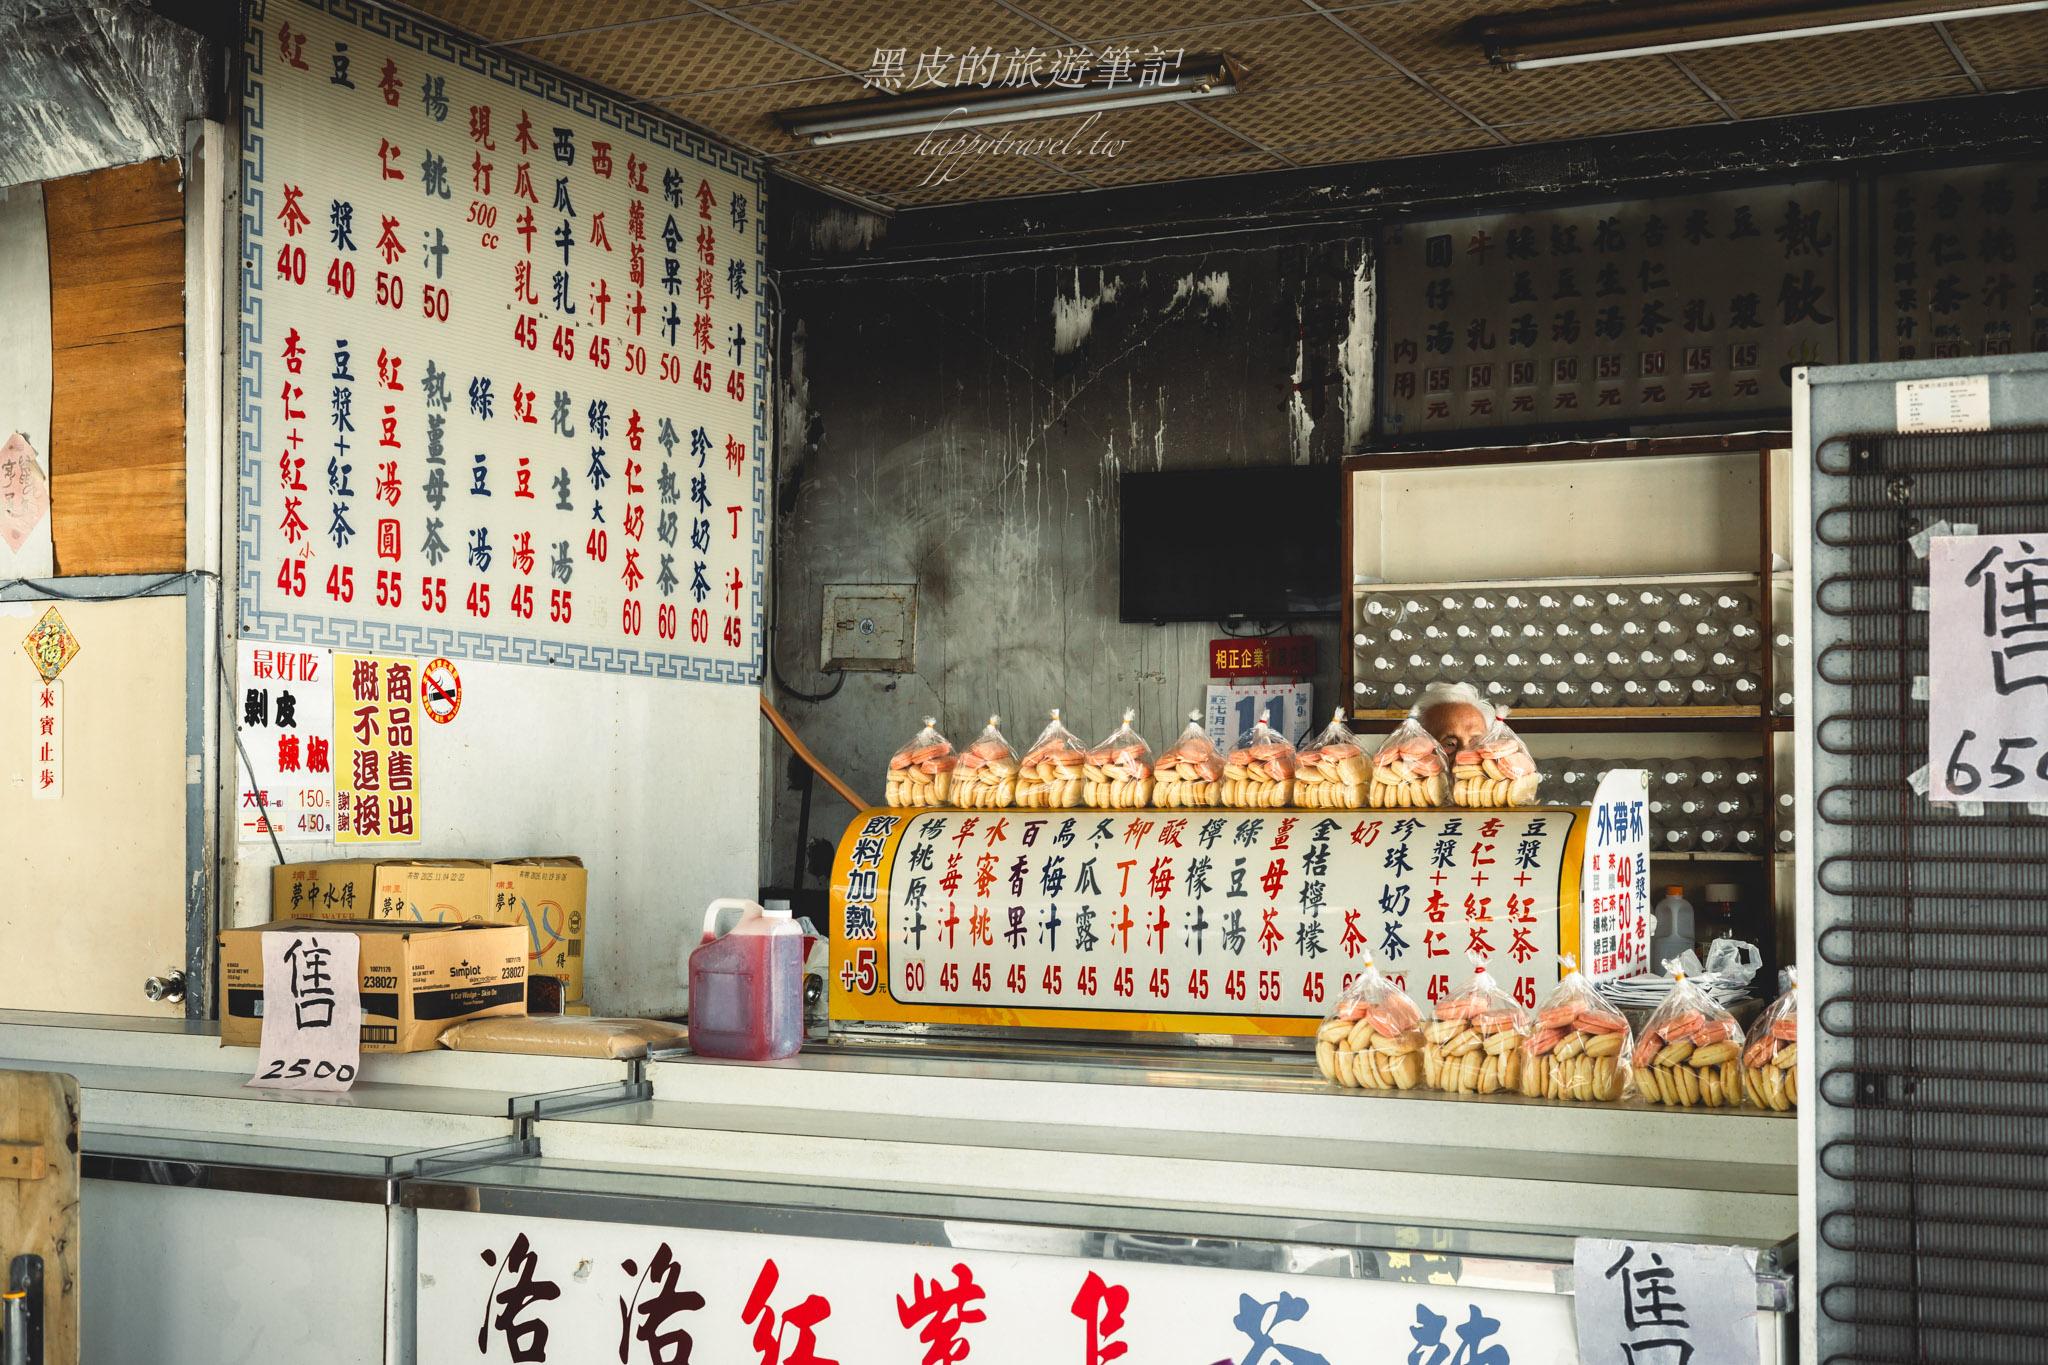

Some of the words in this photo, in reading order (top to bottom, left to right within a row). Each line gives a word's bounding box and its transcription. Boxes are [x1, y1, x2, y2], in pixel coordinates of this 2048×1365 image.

[277, 22, 311, 236] 紅茶
[329, 42, 357, 251] 豆漿
[376, 58, 407, 265] 杏仁茶
[469, 105, 496, 196] 現打
[421, 73, 451, 279] 楊桃汁
[514, 108, 539, 305] 木瓜牛乳
[552, 127, 577, 315] 西瓜牛乳
[589, 140, 613, 326] 西瓜汁
[626, 152, 649, 336] 紅蘿蔔汁
[277, 243, 306, 285] 40
[661, 167, 684, 347] 綜合果汁
[692, 179, 717, 355] 金桔檸檬
[327, 258, 355, 299] 40
[376, 271, 403, 310] 50
[727, 191, 749, 367] 檸檬汁
[423, 284, 450, 323] 50
[514, 314, 538, 351] 45
[552, 325, 575, 361] 45
[589, 335, 611, 370] 45
[624, 343, 646, 376] 50
[659, 353, 681, 384] 50
[693, 360, 712, 393] 45
[726, 370, 745, 402] 45
[376, 347, 404, 563] 紅豆湯圓
[420, 359, 452, 567] 熱薑母茶
[468, 376, 495, 572] 綠豆湯
[512, 382, 538, 575] 紅豆湯
[550, 390, 575, 585] 花生湯
[621, 408, 645, 592] 杏仁奶茶
[656, 417, 680, 597] 冷熱奶茶
[690, 426, 713, 603] 珍珠奶茶
[725, 434, 745, 610] 柳丁汁
[586, 529, 607, 562] 40
[277, 558, 306, 597] 45
[326, 564, 354, 603] 45
[376, 570, 402, 608] 55
[422, 576, 447, 614] 55
[466, 582, 490, 618] 45
[511, 584, 533, 619] 45
[550, 589, 572, 624] 55
[623, 598, 641, 636] 60
[658, 603, 676, 640] 60
[691, 607, 708, 643] 60
[724, 616, 741, 648] 45
[253, 649, 319, 682] 最好吃
[1216, 649, 1264, 669] 相正企業
[244, 688, 297, 728] 剝皮
[39, 687, 55, 789] 來賓止步
[278, 734, 330, 773] 辣椒
[352, 659, 381, 836] 概不退換
[386, 662, 413, 835] 商品售出
[299, 789, 324, 808] 150
[338, 791, 350, 832] 謝謝
[243, 816, 269, 833] 一盒
[297, 813, 324, 832] 450
[1597, 801, 1644, 847] 外帶杯
[845, 815, 899, 941] 飲料加熱
[903, 817, 946, 950] 楊桃原汁
[938, 816, 979, 949] 草莓汁
[969, 816, 1010, 947] 水蜜桃
[1004, 820, 1047, 949] 百香果
[1039, 817, 1077, 952] 烏梅汁
[1075, 817, 1114, 952] 冬瓜露
[1111, 818, 1151, 954] 柳丁汁
[1147, 817, 1187, 955] 酸梅汁
[1185, 819, 1228, 956] 檸檬汁
[1222, 818, 1265, 956] 綠豆湯
[1257, 817, 1299, 956] 薑母茶
[1296, 817, 1342, 960] 金桔檸檬
[1339, 820, 1383, 959] 奶茶
[1379, 817, 1425, 961] 珍珠奶茶
[1617, 856, 1631, 888] 40
[1618, 892, 1631, 930] 50
[1617, 932, 1632, 964] 45
[364, 976, 398, 989] 238027
[450, 965, 481, 979] Simplot
[502, 966, 525, 980] 238027
[905, 963, 924, 992] 60
[940, 962, 959, 992] 45
[972, 962, 991, 992] 45
[1006, 963, 1027, 994] 45
[1042, 965, 1062, 995] 45
[1077, 966, 1098, 996] 45
[1113, 967, 1134, 997] 45
[1150, 968, 1170, 998] 45
[1188, 969, 1209, 1000] 45
[1225, 969, 1246, 1001] 45
[1259, 970, 1280, 1001] 55
[1303, 971, 1324, 1003] 45
[1427, 974, 1450, 1006] 45
[1513, 976, 1536, 1009] 45
[260, 1059, 355, 1082] 2500
